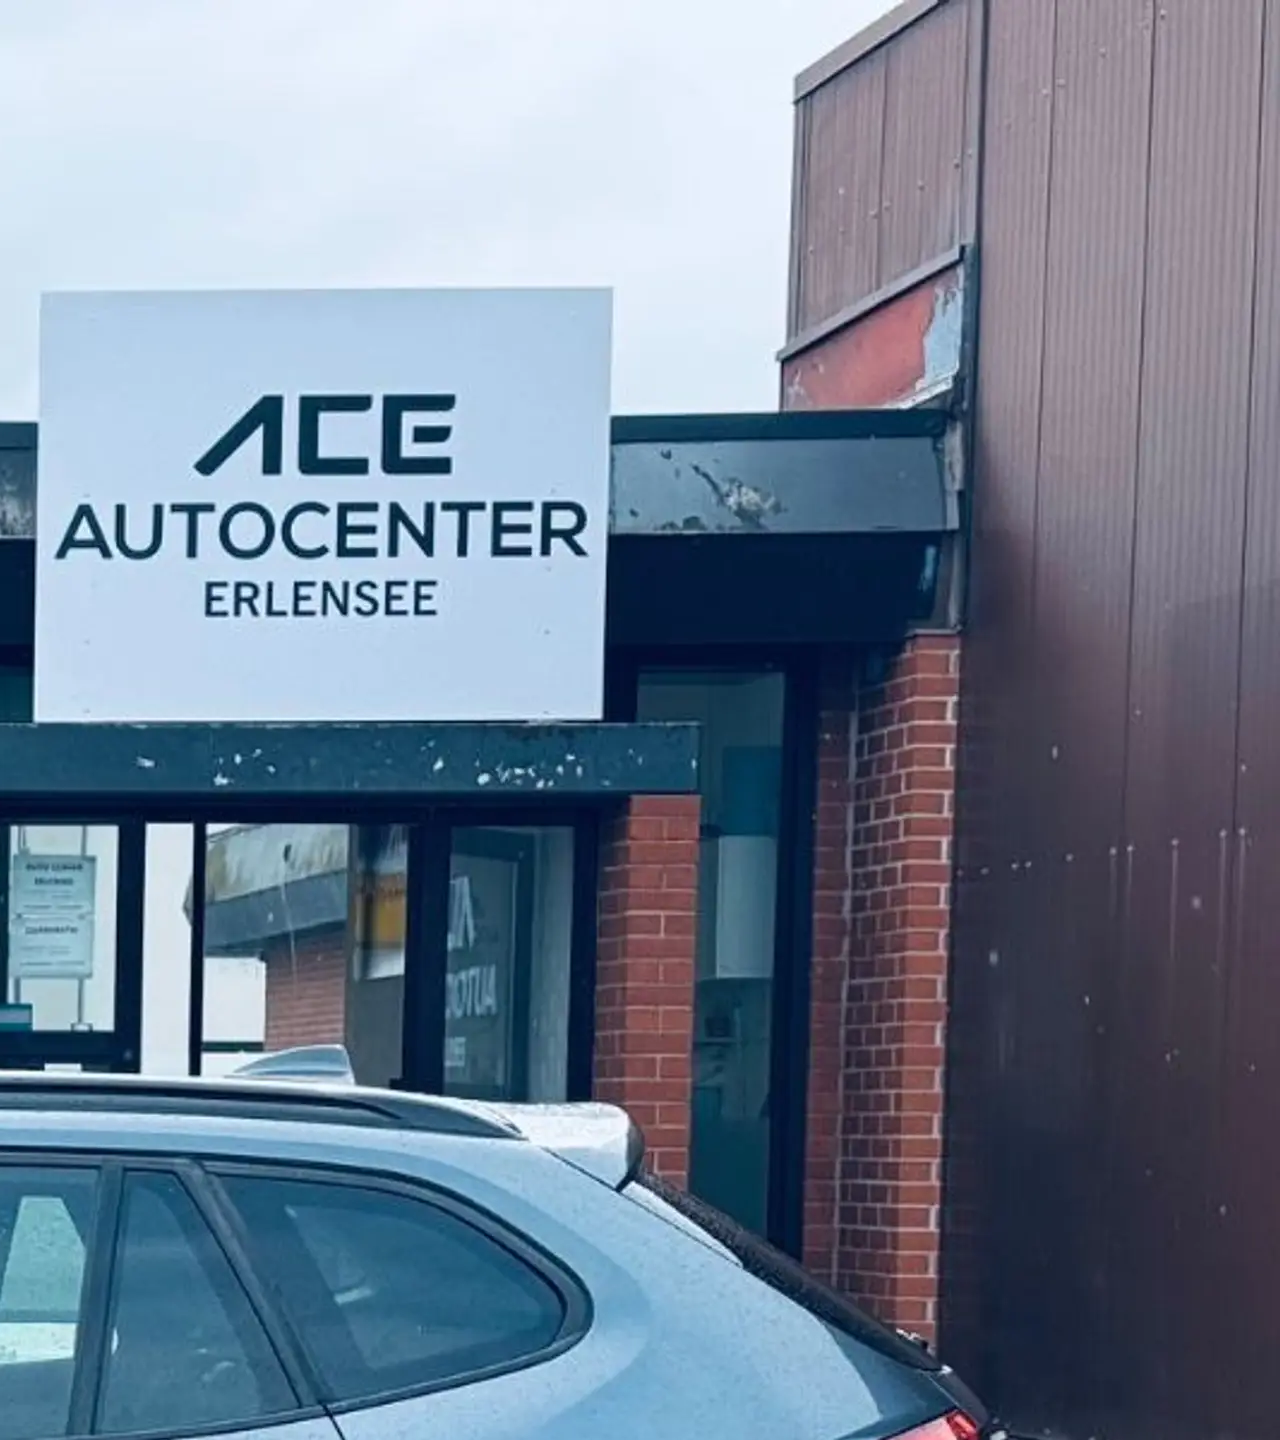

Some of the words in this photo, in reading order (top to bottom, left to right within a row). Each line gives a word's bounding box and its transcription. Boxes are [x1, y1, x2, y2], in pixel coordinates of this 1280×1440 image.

[193, 393, 456, 477] ACE
[54, 501, 589, 561] AUTOCENTER
[204, 580, 438, 618] ERLENSEE
